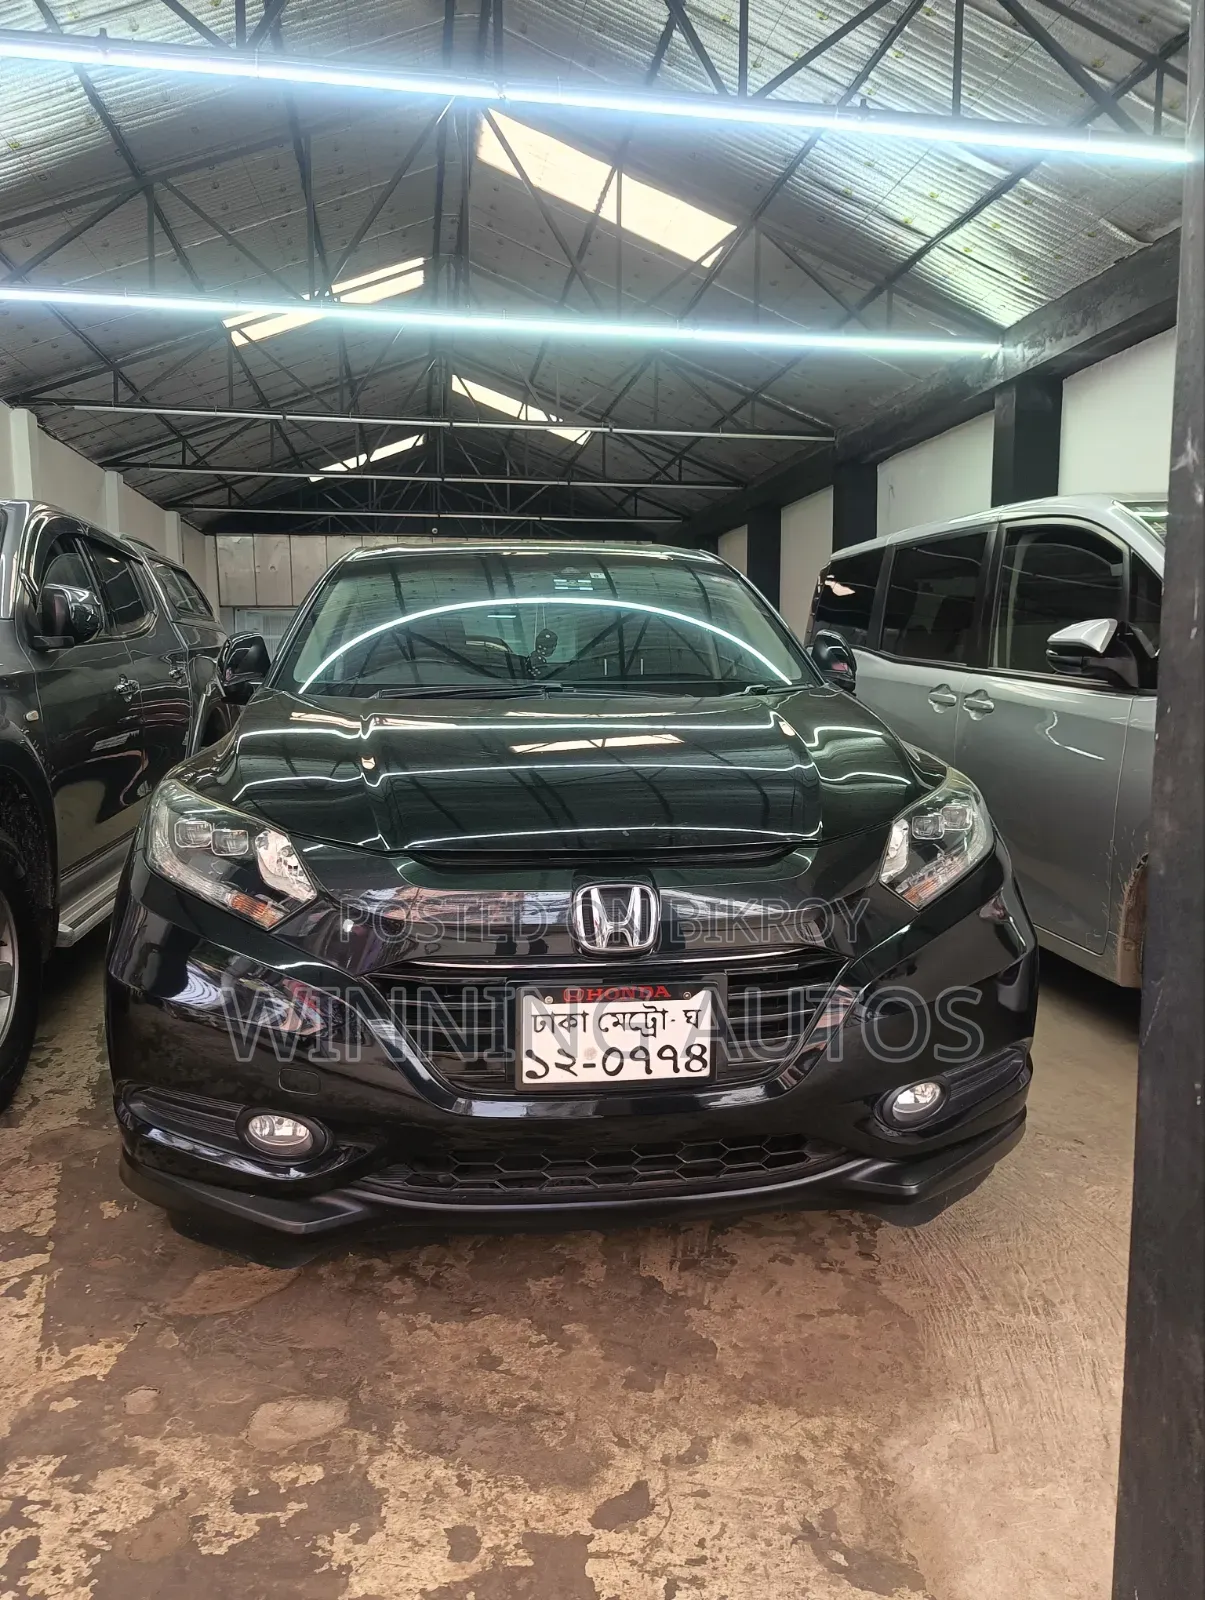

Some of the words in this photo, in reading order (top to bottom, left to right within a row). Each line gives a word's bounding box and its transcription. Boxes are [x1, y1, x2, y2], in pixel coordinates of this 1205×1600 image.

[588, 985, 671, 1001] HONDA
[531, 1010, 589, 1034] ঢাকা
[525, 1043, 708, 1079] ১২-০৭৭৪
